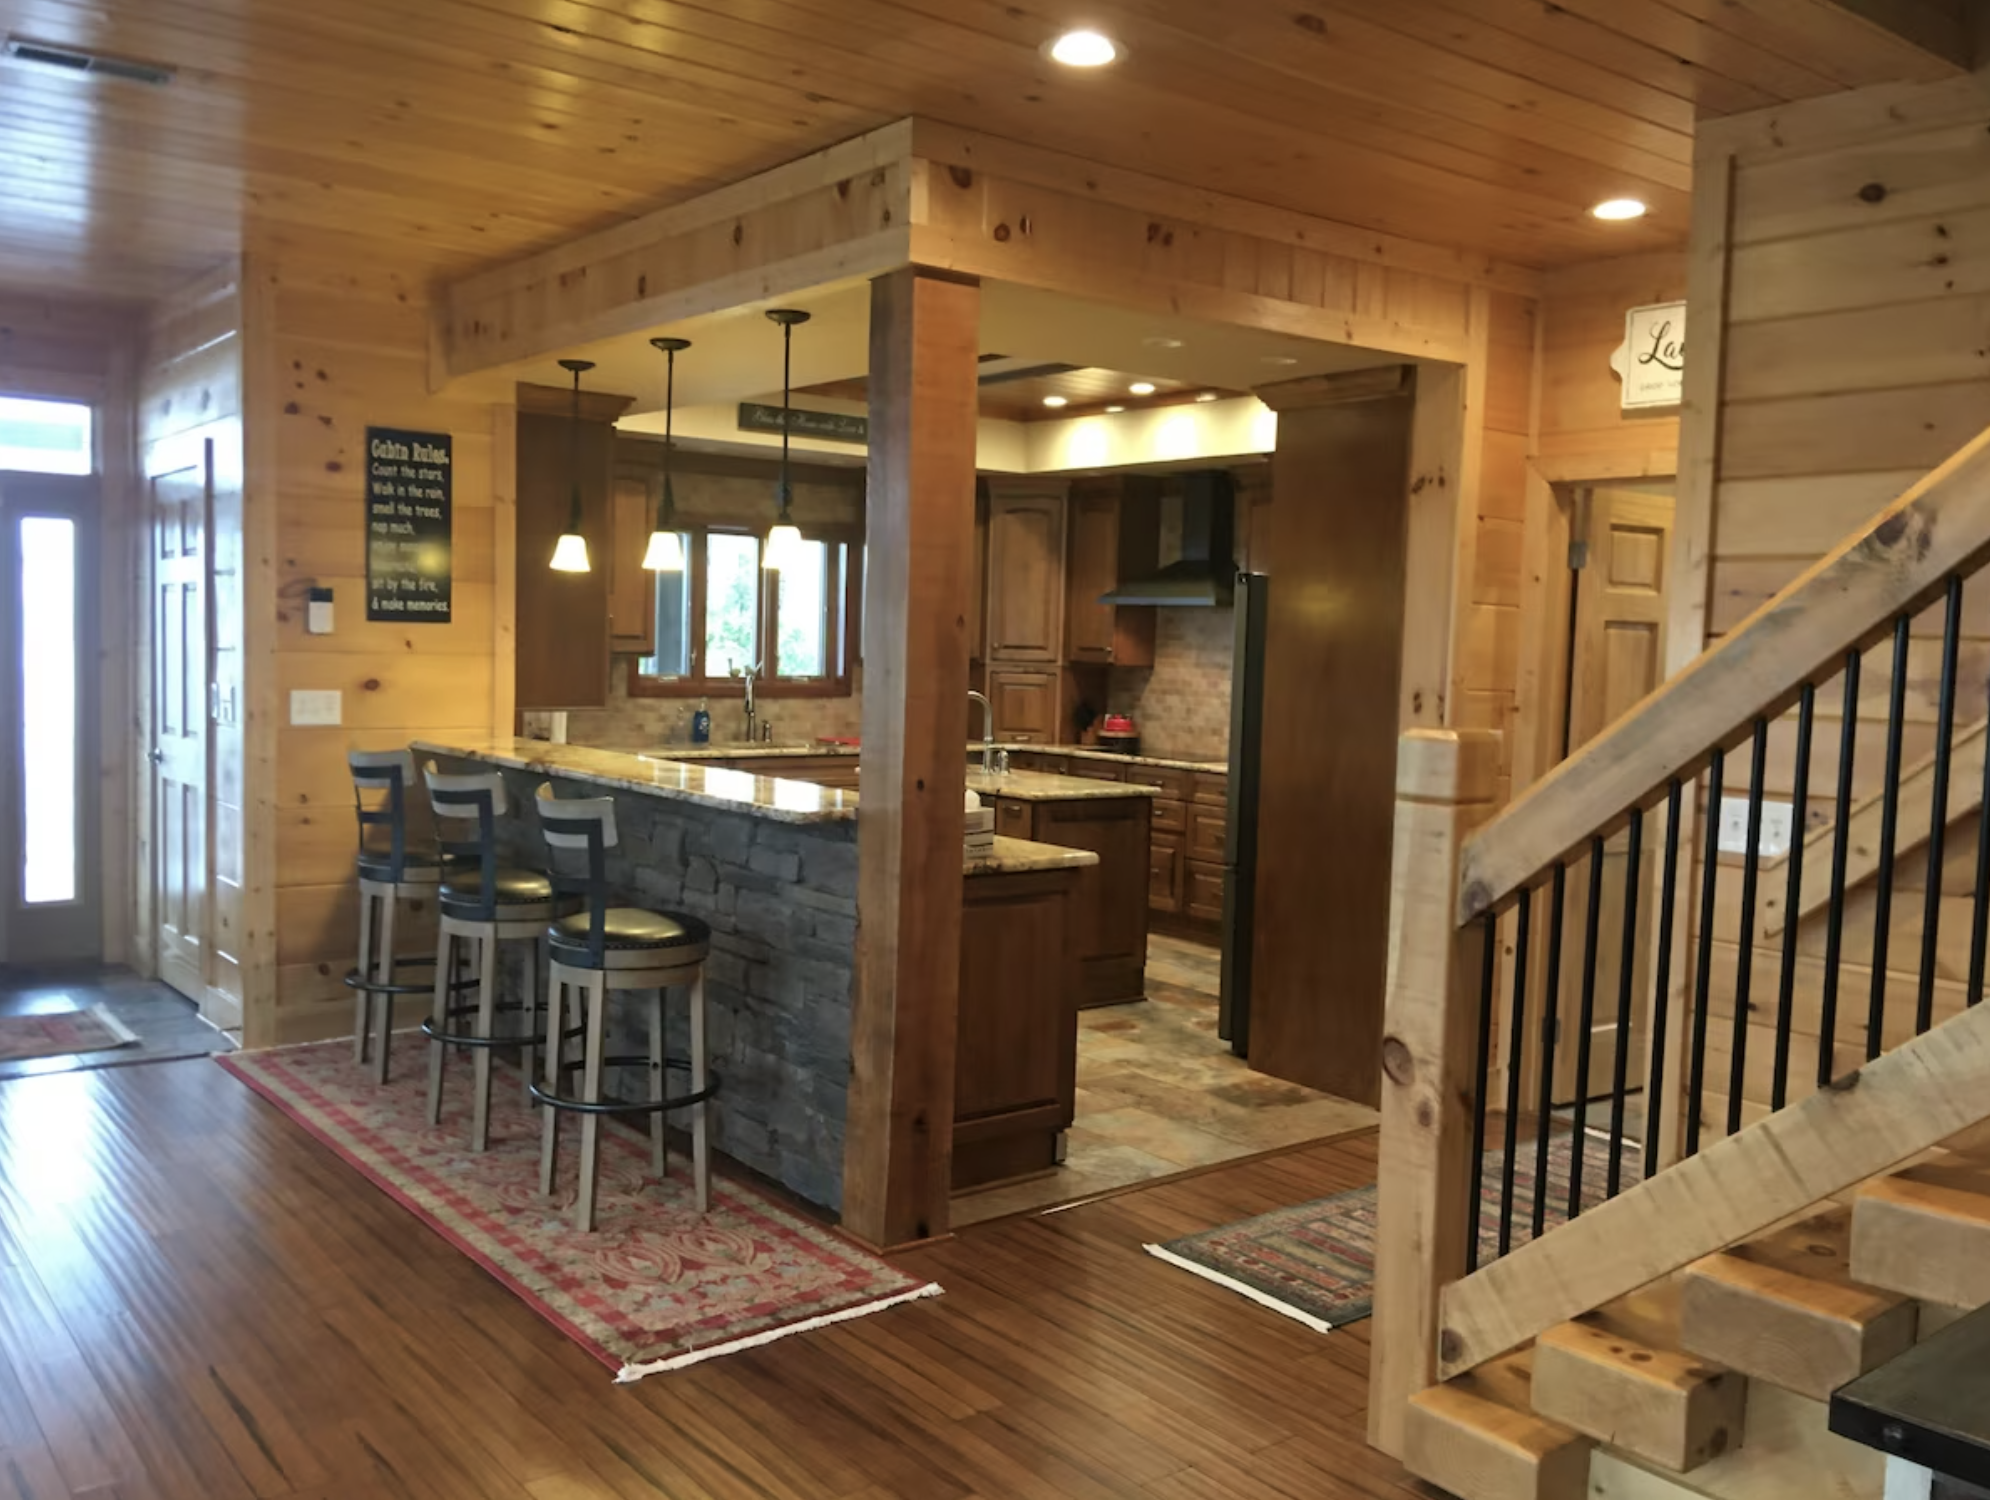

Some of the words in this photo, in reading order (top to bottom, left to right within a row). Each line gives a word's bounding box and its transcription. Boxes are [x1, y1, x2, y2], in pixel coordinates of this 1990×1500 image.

[371, 438, 409, 461] Cabin
[371, 461, 398, 477] Count
[400, 464, 416, 479] the
[418, 467, 445, 483] stars,
[372, 481, 395, 496] Walk
[397, 482, 406, 497] in
[408, 484, 423, 499] the
[425, 486, 445, 502] rain,
[372, 500, 395, 515] smell
[397, 502, 413, 517] the
[415, 504, 442, 520] trees,
[371, 521, 388, 535] nap
[390, 520, 416, 536] much,
[385, 577, 399, 593] by
[401, 577, 416, 591] the
[418, 576, 439, 593] fire,
[371, 595, 379, 611] &
[380, 596, 405, 611] make
[406, 598, 450, 613] memories.
